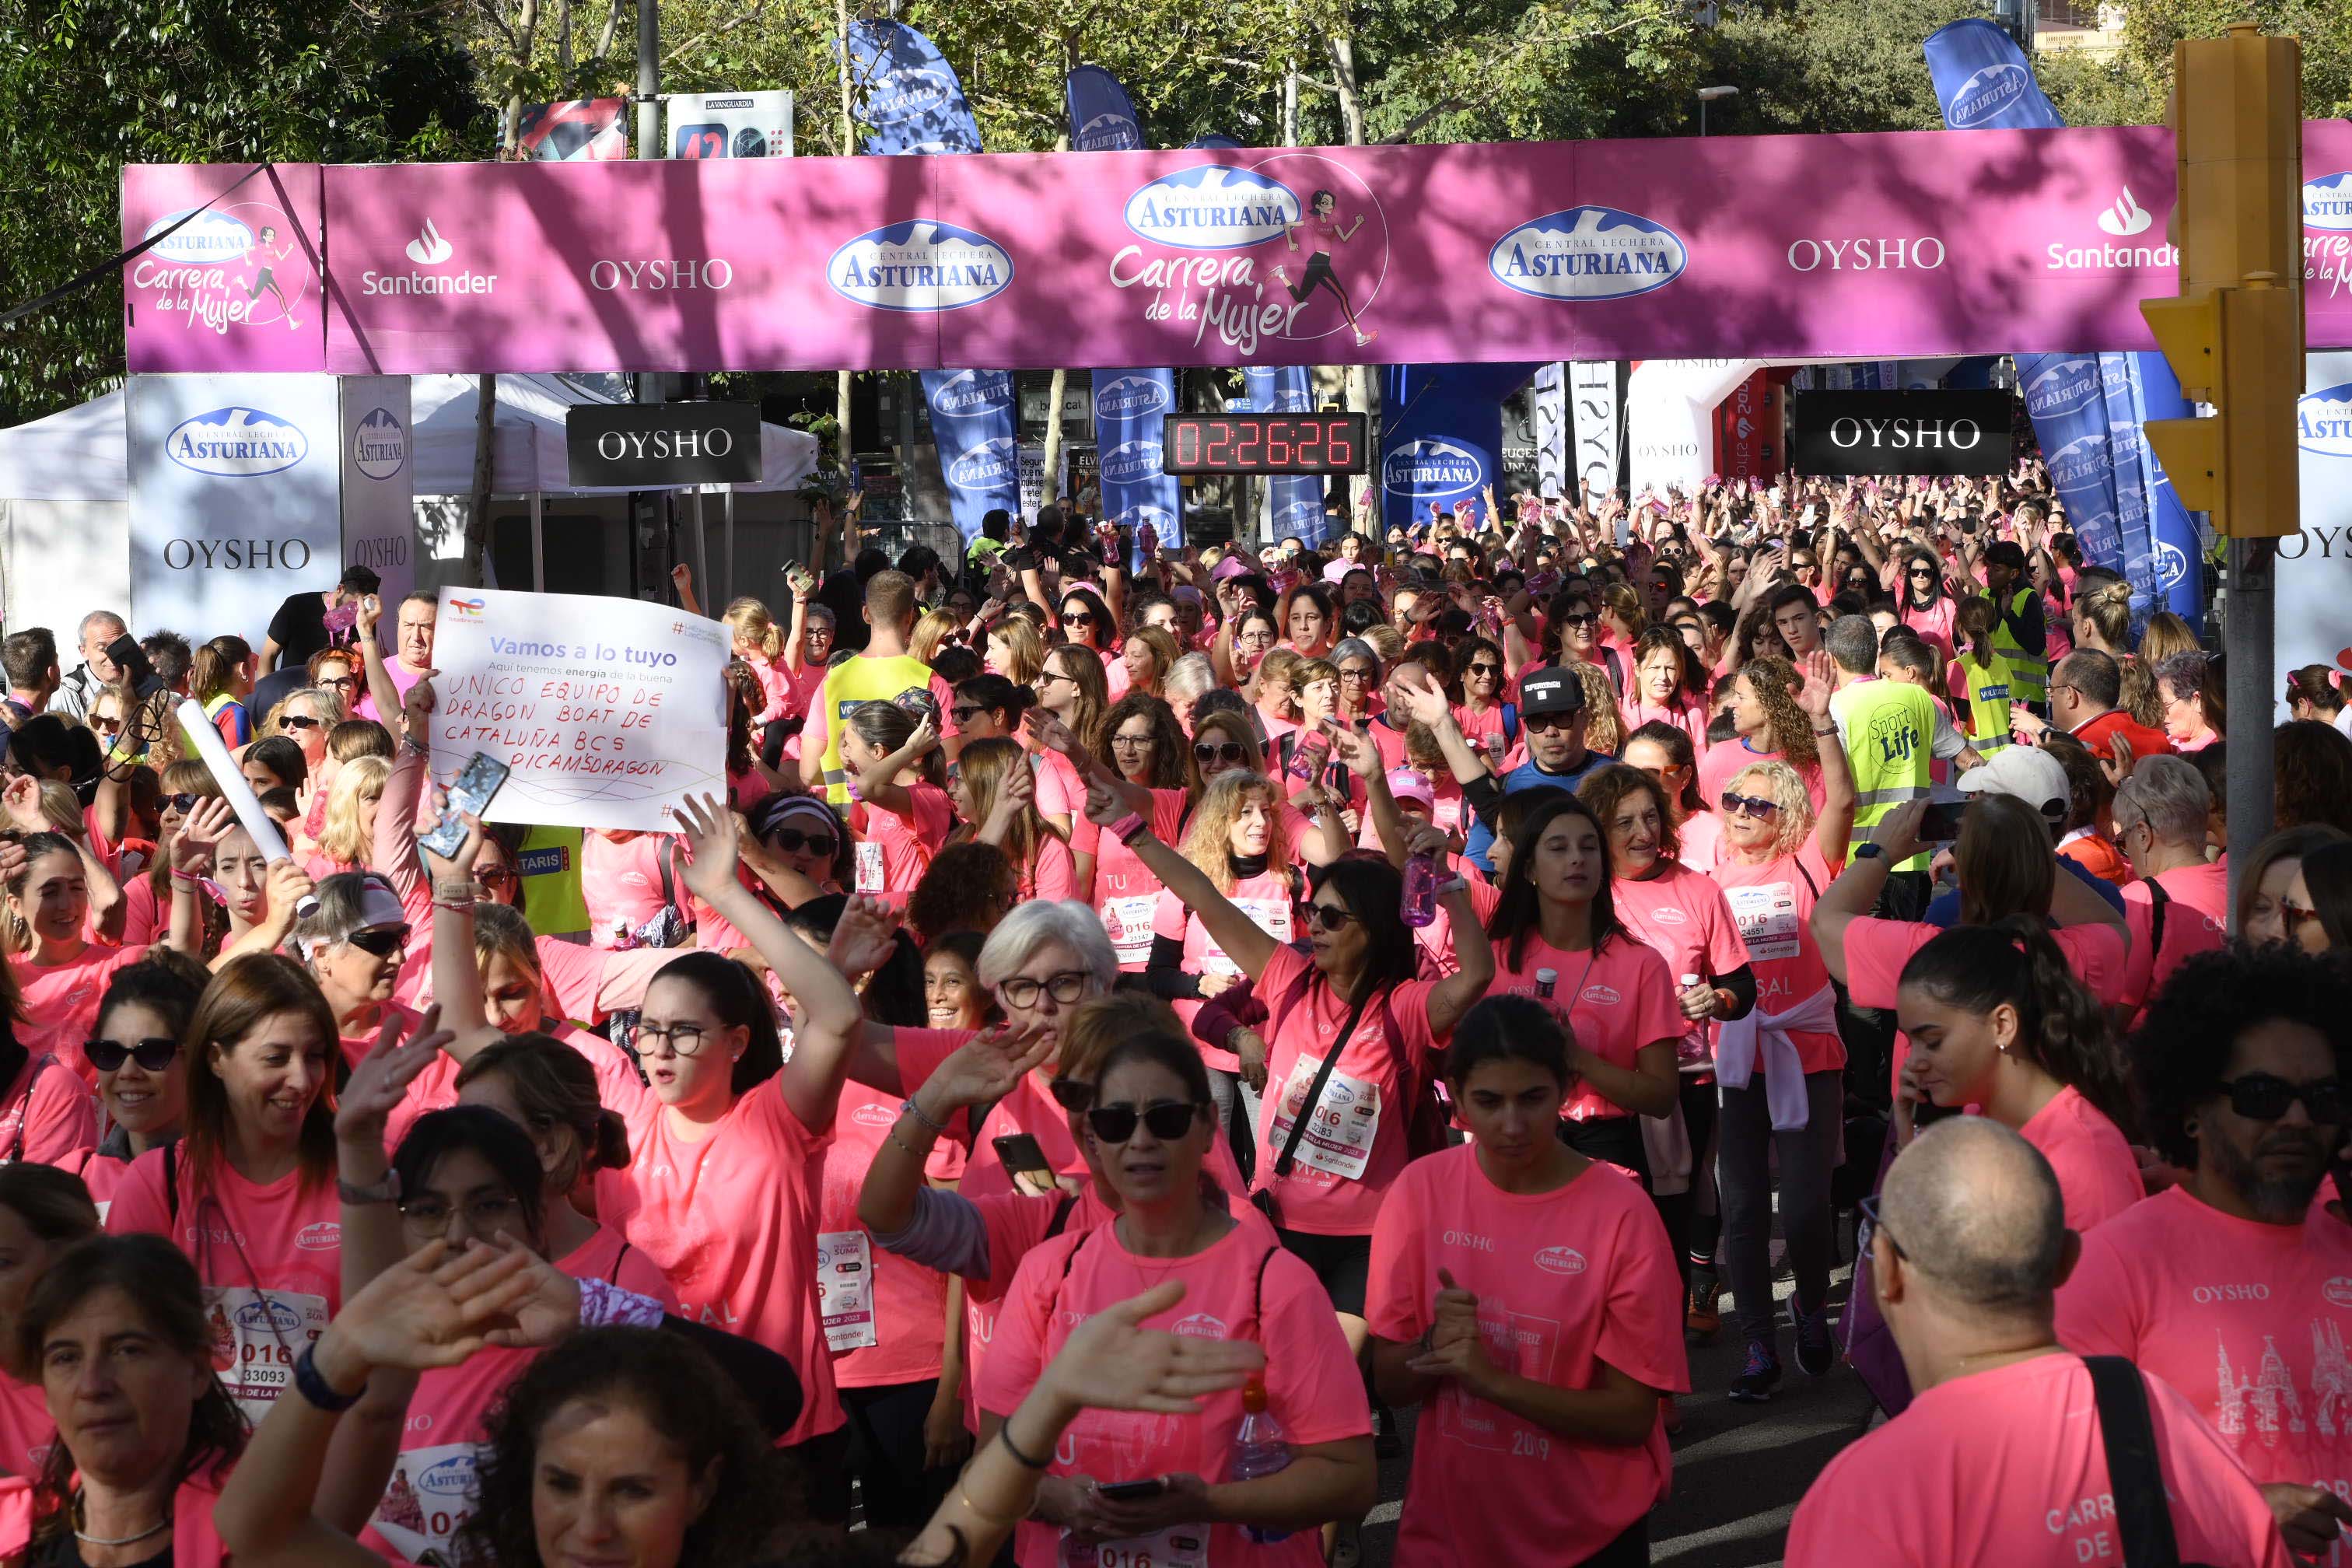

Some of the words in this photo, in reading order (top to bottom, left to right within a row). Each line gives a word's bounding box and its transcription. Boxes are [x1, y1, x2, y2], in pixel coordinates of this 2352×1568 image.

[1165, 194, 1220, 202] CENTRAL
[1139, 197, 1288, 228] ASTURIANA
[153, 229, 243, 250] ASTURIANA
[1535, 240, 1595, 248] CENTRAL
[1602, 239, 1665, 247] LECHERA
[870, 252, 928, 261] CENTRAL
[935, 250, 993, 259] LECHERA
[1504, 243, 1671, 277] ASTURIANA
[1789, 237, 1945, 271] OYSHO
[133, 261, 225, 289] Carrera
[590, 258, 733, 291] OYSHO
[842, 254, 999, 287] ASTURIANA
[1109, 245, 1255, 289] Carrera
[2319, 260, 2333, 280] la
[362, 271, 498, 295] Santander
[156, 292, 173, 310] de
[177, 291, 188, 310] la
[187, 285, 259, 334] Mujer
[1145, 291, 1171, 320] de
[1178, 291, 1198, 320] la
[1193, 283, 1309, 355] Mujer
[1830, 417, 1980, 449] OYSHO
[177, 432, 297, 460] ASTURIANA
[358, 435, 402, 463] ASTURIANA
[598, 429, 733, 460] OYSHO
[1178, 423, 1349, 465] 02:26:26
[1639, 444, 1698, 457] OYSHO
[1020, 470, 1034, 478] que
[1385, 463, 1474, 485] ASTURIANA
[163, 538, 310, 570] OYSHO
[355, 535, 406, 569] OYSHO
[490, 636, 566, 658] Vamos
[574, 646, 586, 659] a
[596, 643, 616, 661] lo
[625, 646, 677, 668] tuyo
[516, 663, 562, 675] tenemos
[565, 669, 606, 679] energía
[610, 670, 623, 680] de
[627, 672, 635, 681] la
[639, 673, 673, 684] buena
[449, 674, 525, 695] UNICO
[541, 682, 620, 704] EQUIPO
[633, 688, 663, 708] DE
[446, 698, 536, 722] DRAGON
[556, 705, 614, 723] BOAT
[621, 711, 652, 728] DE
[1870, 708, 1911, 740] Sport
[445, 726, 560, 748] CATALUÑA
[574, 730, 625, 751] BCS
[1881, 726, 1920, 763] Life
[1106, 874, 1126, 890] TU
[1125, 921, 1151, 933] 016
[1654, 912, 1685, 922] ASTURIANA
[1738, 914, 1768, 926] 016
[1741, 928, 1765, 936] 24551
[1767, 946, 1795, 954] Santander
[1584, 992, 1618, 1002] ASTURIANA
[856, 1111, 893, 1123] ASTURIANA
[1315, 1105, 1341, 1125] 016
[1321, 1140, 1343, 1152] MUJER
[1325, 1154, 1356, 1170] Santander
[834, 1247, 859, 1255] SUMA
[1539, 1255, 1583, 1270] ASTURIANA
[2193, 1283, 2270, 1304] OYSHO
[239, 1311, 296, 1327] ASTURIANA
[823, 1317, 841, 1326] UJER
[825, 1329, 864, 1342] Santander
[241, 1344, 292, 1364] 016
[244, 1370, 285, 1384] 33093
[246, 1388, 259, 1397] DE
[261, 1388, 274, 1397] LA
[2046, 1494, 2115, 1535] CARR
[2075, 1531, 2111, 1563] DE
[1102, 1548, 1151, 1568] 016
